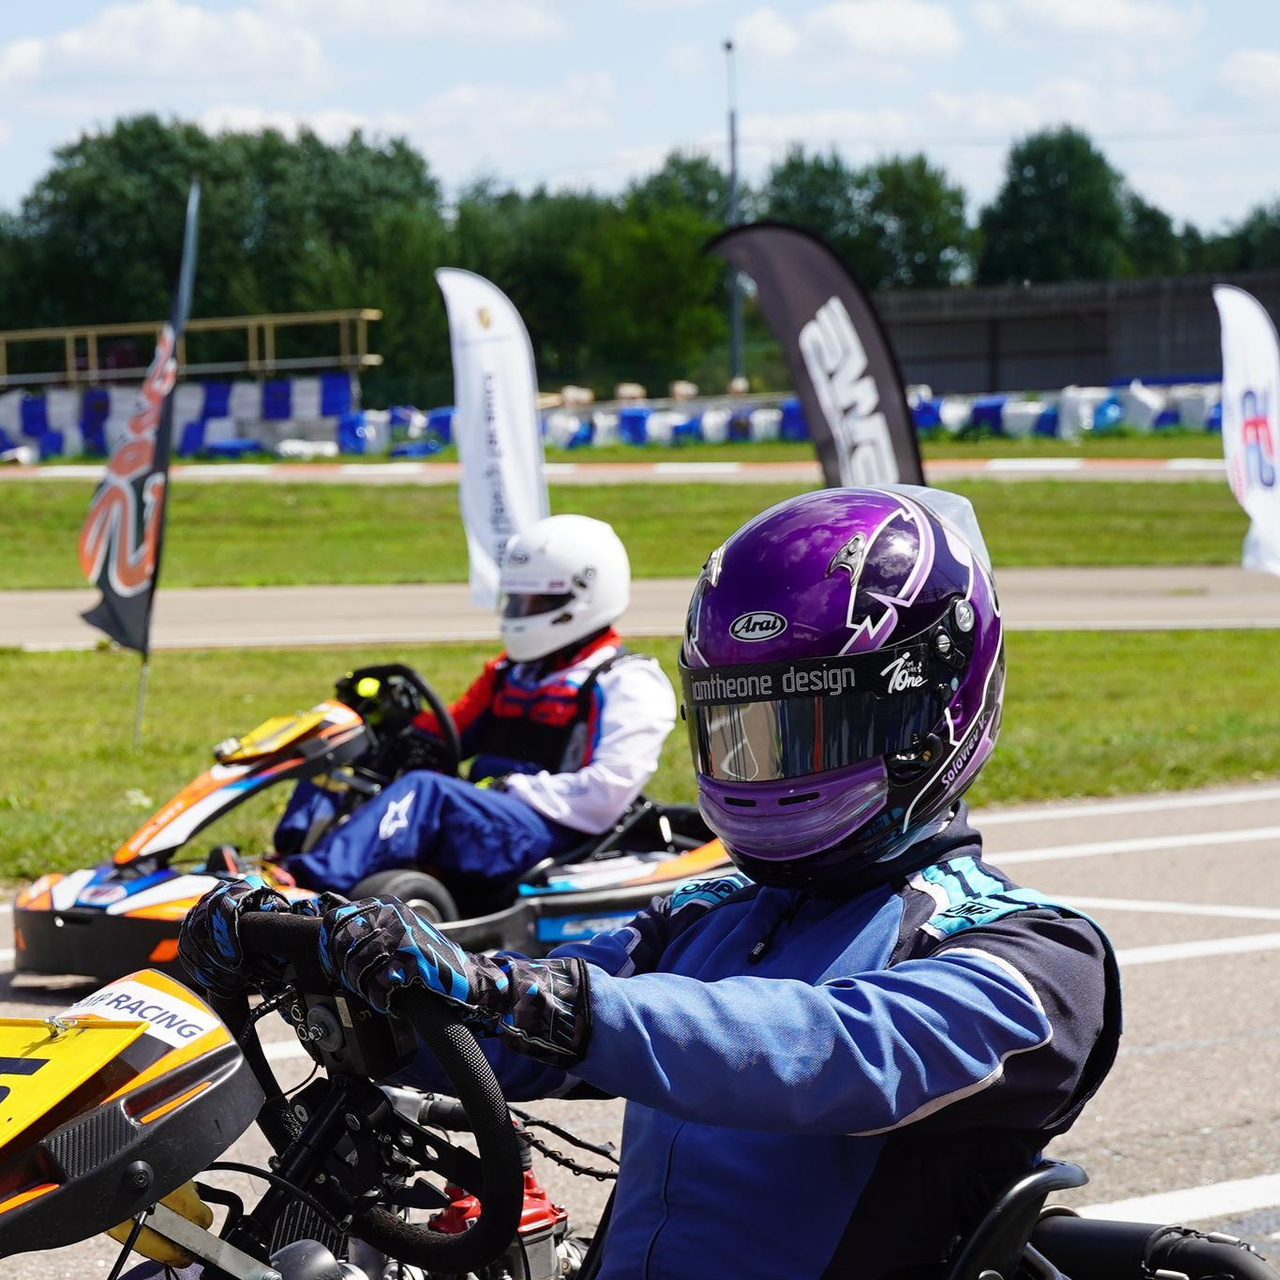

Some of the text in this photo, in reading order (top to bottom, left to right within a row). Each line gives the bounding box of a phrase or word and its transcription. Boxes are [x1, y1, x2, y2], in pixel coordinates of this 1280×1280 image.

[733, 615, 779, 636] Arai
[782, 663, 856, 696] design
[105, 993, 204, 1039] RACING
